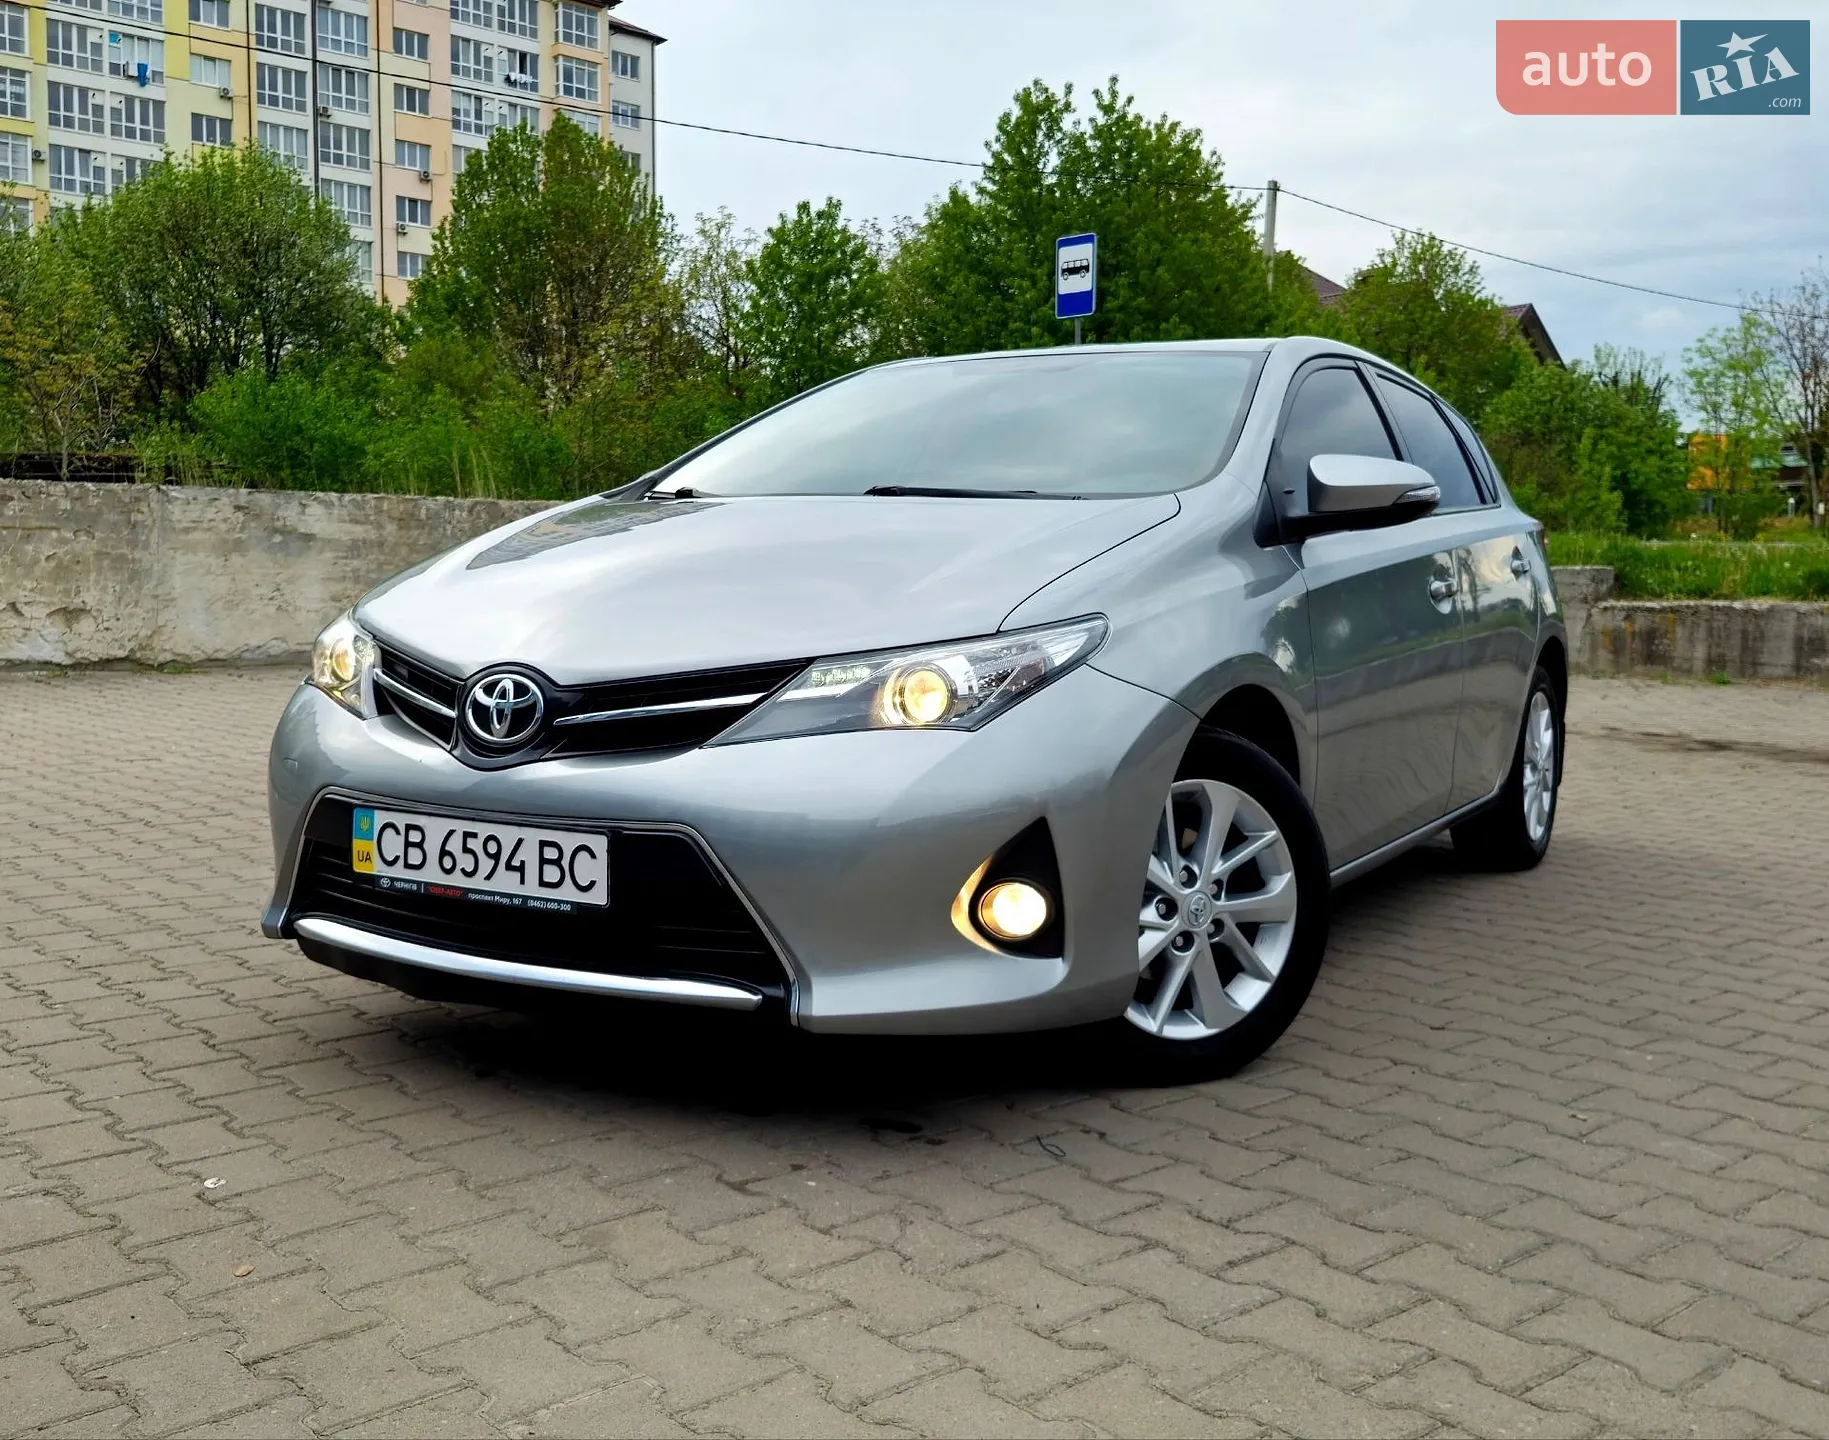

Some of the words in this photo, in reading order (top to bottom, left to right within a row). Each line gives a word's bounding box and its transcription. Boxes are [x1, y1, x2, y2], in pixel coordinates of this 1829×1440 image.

[357, 849, 373, 864] UA
[377, 821, 427, 870] CB
[438, 829, 525, 885] 6594
[538, 839, 598, 893] BC
[527, 899, 547, 909] (0462)
[547, 901, 572, 911] 600-300
